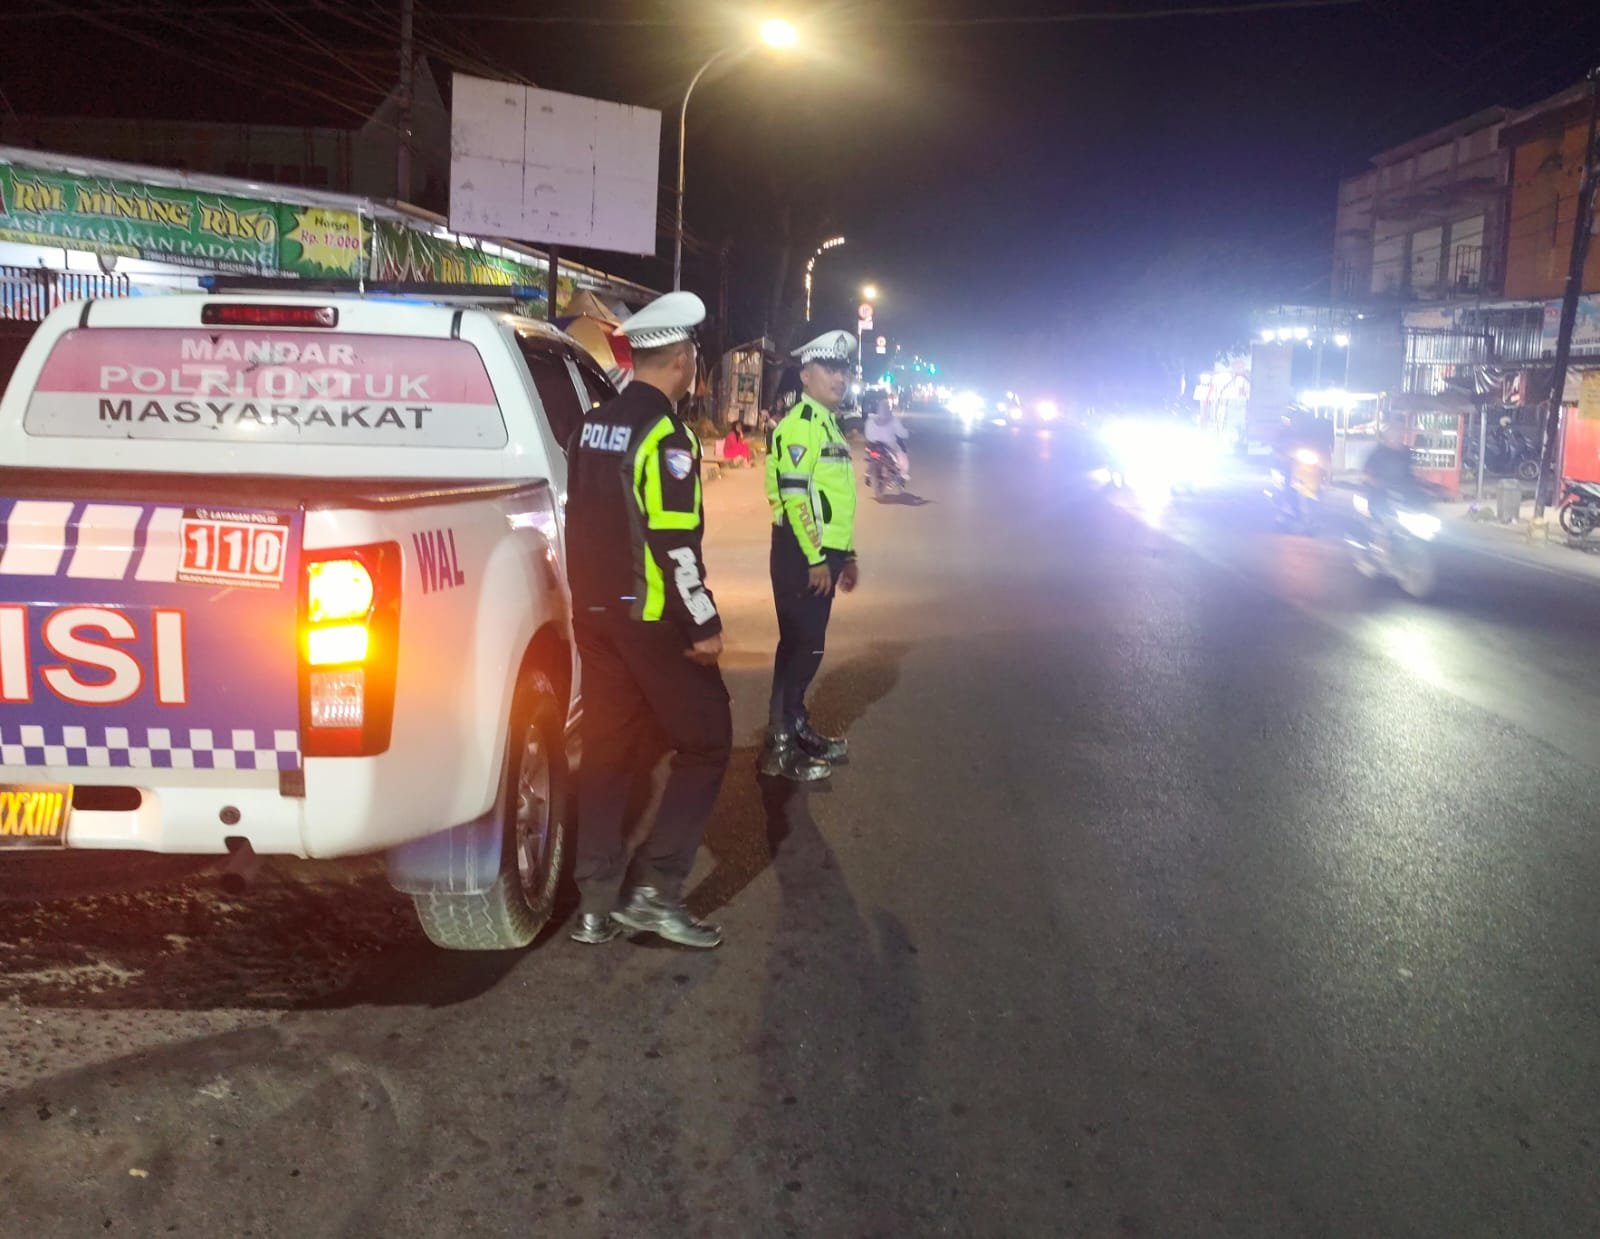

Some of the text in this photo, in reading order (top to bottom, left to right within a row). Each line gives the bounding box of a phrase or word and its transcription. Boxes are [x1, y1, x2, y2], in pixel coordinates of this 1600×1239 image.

[75, 182, 192, 230] MINING
[197, 197, 278, 244] RISO
[62, 222, 174, 251] MASAKAN
[181, 239, 274, 266] PADANG
[181, 338, 355, 366] MANDAR
[98, 398, 433, 430] MASYARAKAT
[579, 422, 632, 452] POLISI
[188, 527, 282, 574] 110
[412, 528, 465, 595] WAL
